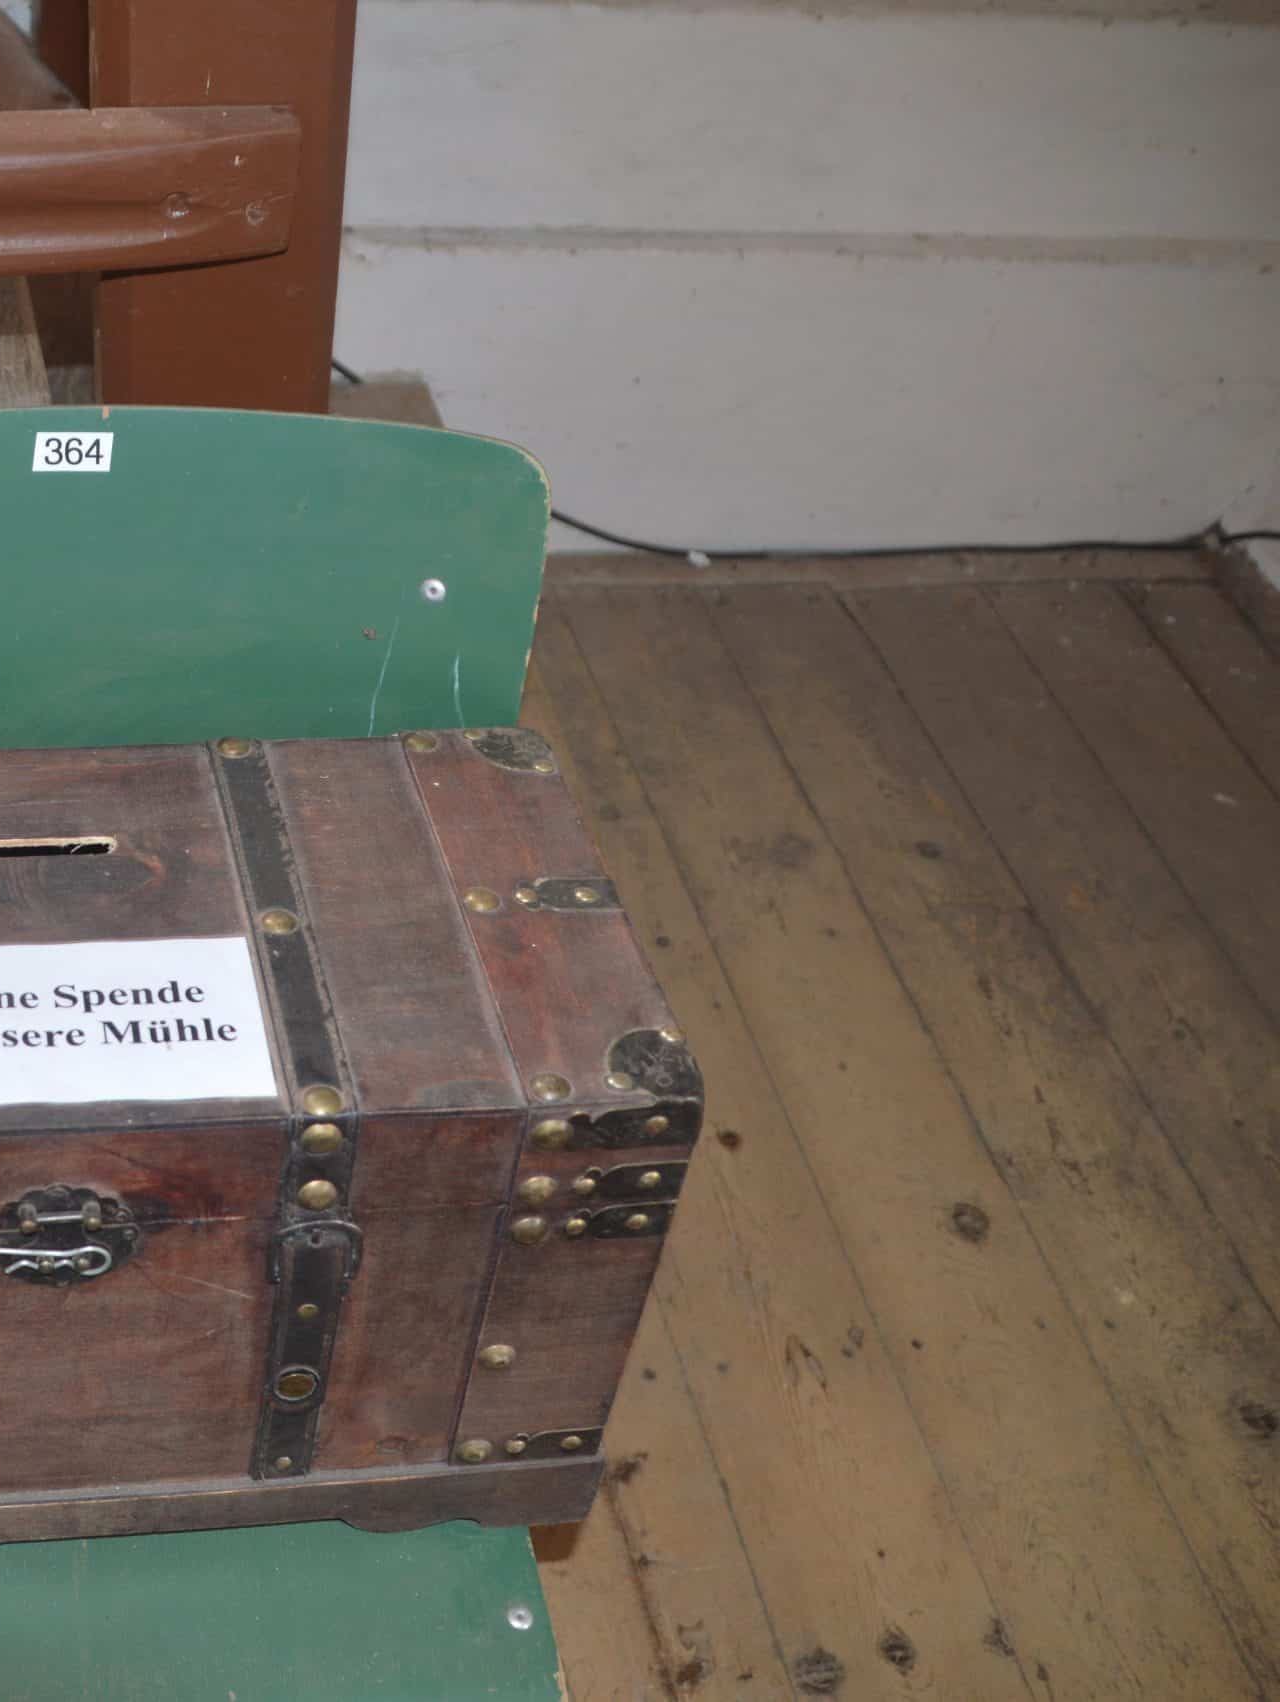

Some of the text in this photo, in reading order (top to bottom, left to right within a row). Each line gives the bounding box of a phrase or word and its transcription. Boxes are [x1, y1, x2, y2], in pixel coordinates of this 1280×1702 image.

[44, 438, 104, 465] 364
[53, 981, 206, 1013] Spende
[100, 1018, 239, 1045] Mühle
